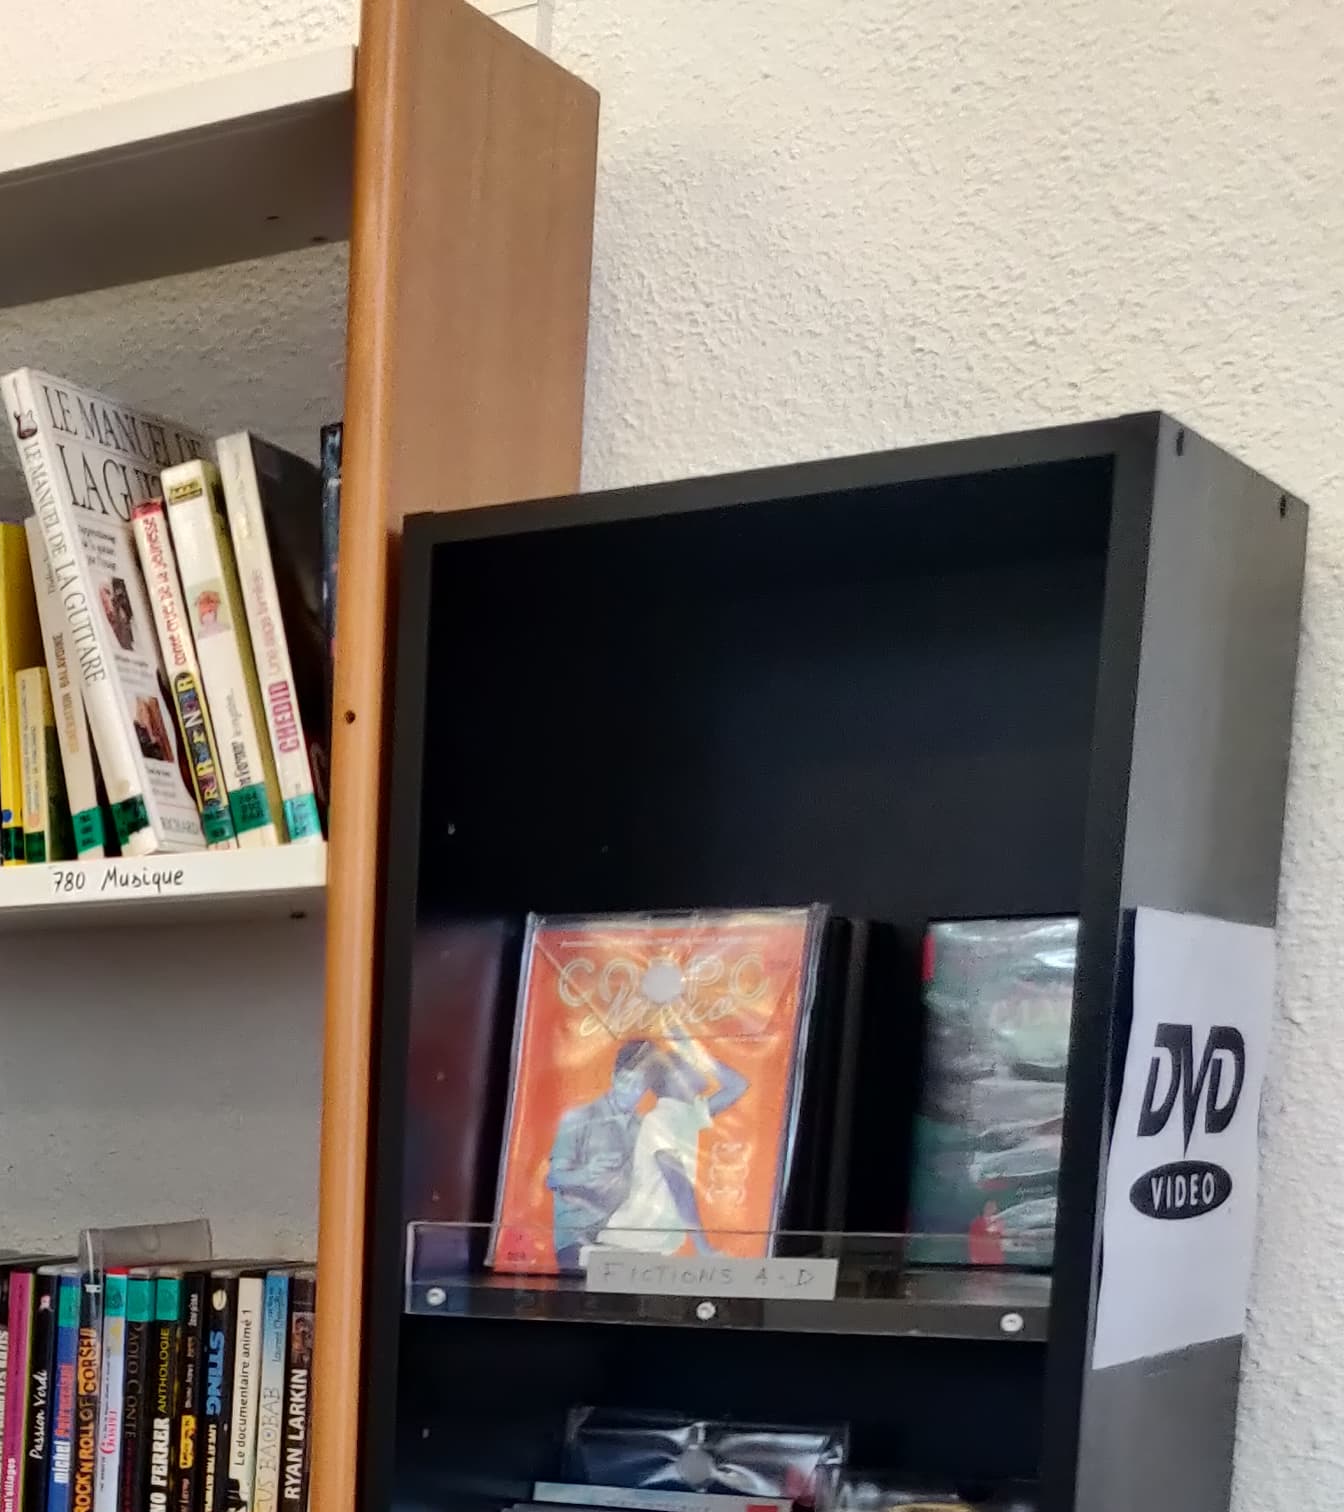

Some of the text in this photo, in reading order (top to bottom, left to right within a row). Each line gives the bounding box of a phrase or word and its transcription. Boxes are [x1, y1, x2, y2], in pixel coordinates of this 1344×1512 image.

[23, 442, 107, 686] LE MANUEL DE LA GUITARE
[267, 680, 301, 755] CHEDID
[53, 867, 184, 891] 780 Musique
[1137, 1023, 1245, 1158] DVD
[1152, 1172, 1215, 1212] VIDEO
[602, 1260, 733, 1286] FICTIONS
[158, 1328, 170, 1413] ANTHOLOGIE
[207, 1330, 224, 1417] STING
[239, 1360, 251, 1447] documentaire
[151, 1417, 170, 1488] FERRER
[285, 1368, 307, 1500] RYAN LARKIN
